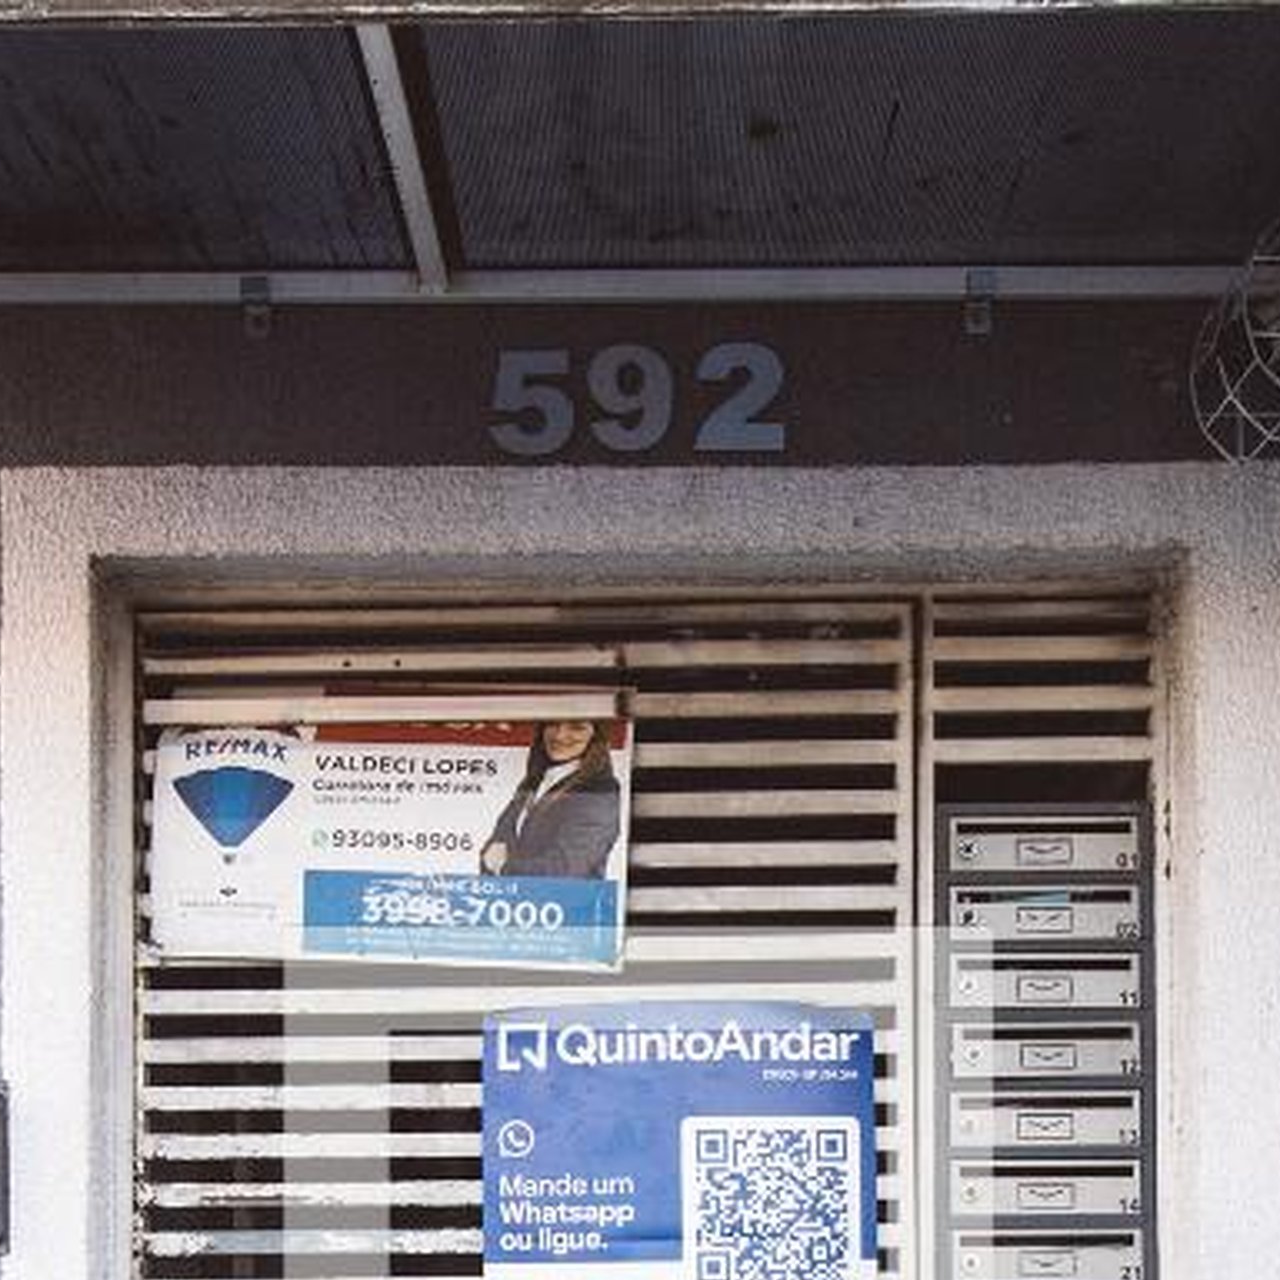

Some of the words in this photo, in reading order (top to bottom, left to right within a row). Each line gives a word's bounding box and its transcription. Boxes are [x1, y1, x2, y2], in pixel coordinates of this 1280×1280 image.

[487, 343, 786, 455] 592
[185, 737, 287, 764] RE/MAX
[315, 755, 415, 774] VALDECI
[423, 758, 499, 777] LOPES
[332, 829, 474, 851] 93095-8906
[556, 1020, 858, 1066] QuintoAndar
[499, 1174, 587, 1197] Mande
[593, 1178, 634, 1196] um
[499, 1202, 634, 1228] Whatsapp
[499, 1234, 532, 1251] ou
[538, 1228, 608, 1256] ligue.
